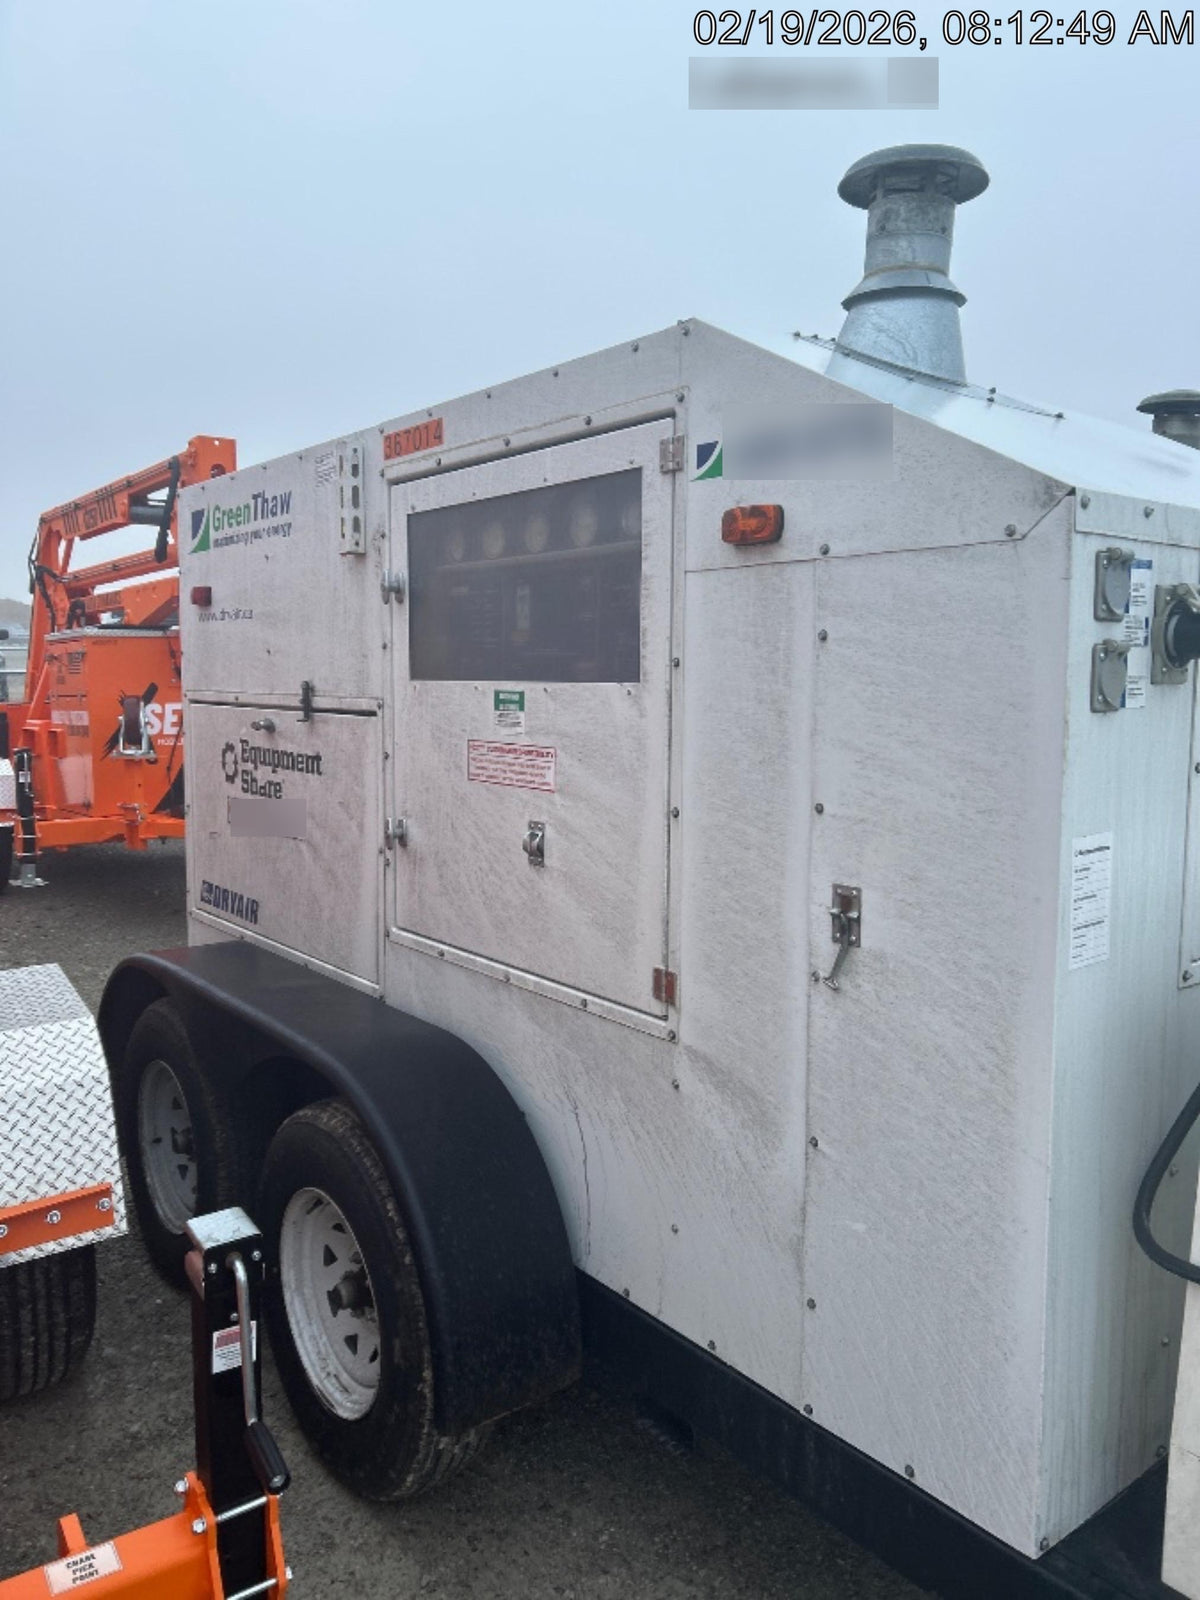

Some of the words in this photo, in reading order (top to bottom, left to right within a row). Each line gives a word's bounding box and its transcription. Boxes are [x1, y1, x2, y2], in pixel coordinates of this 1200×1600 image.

[384, 417, 443, 460] 367014
[212, 489, 292, 532] GreenThaw
[239, 736, 322, 776] Equipment
[241, 769, 282, 800] Share
[213, 884, 259, 925] DRYAIR
[72, 1569, 99, 1584] POINT
